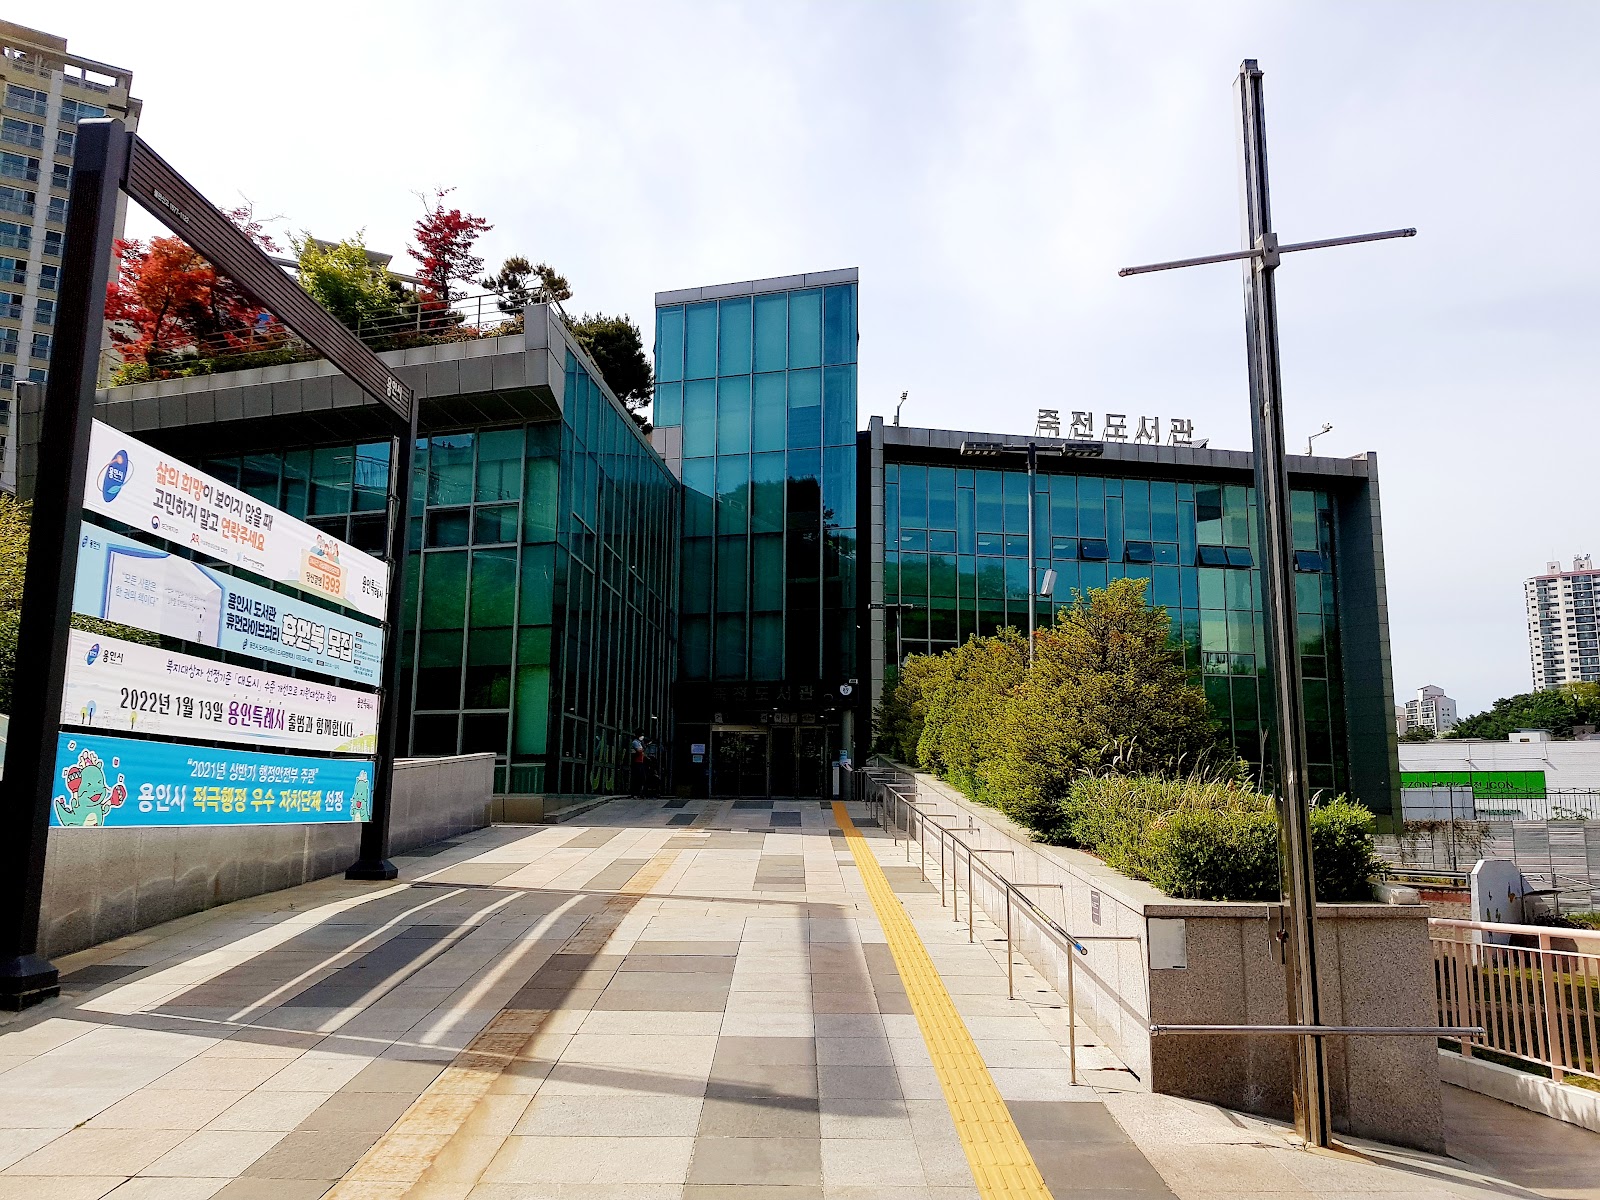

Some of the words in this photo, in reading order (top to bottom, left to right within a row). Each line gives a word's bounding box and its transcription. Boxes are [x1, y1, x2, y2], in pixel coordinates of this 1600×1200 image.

[1038, 408, 1194, 444] 죽전도서관
[156, 461, 180, 488] 삶의
[181, 472, 214, 504] 희망이
[214, 489, 243, 518] 보이지
[246, 503, 262, 528] 않을
[263, 513, 274, 532] 때
[152, 487, 198, 523] 고민하지
[200, 507, 218, 532] 말고
[221, 517, 264, 551] 연락주세요
[116, 585, 122, 598] 한
[322, 574, 340, 594] 1393
[228, 592, 252, 615] 용인시
[254, 602, 277, 622] 도서관
[226, 612, 280, 642] 휴먼라이브러리
[281, 613, 326, 654] 휴먼북
[327, 627, 353, 662] 모집
[102, 649, 124, 663] 용인시
[166, 658, 204, 679] 복지대상자
[206, 667, 232, 686] 선정기준
[264, 680, 276, 694] 수준
[277, 683, 298, 696] 개선으로
[300, 687, 326, 702] 지원대상자
[327, 690, 337, 704] 확대
[120, 687, 170, 716] 2022년
[175, 696, 194, 718] 1월
[198, 700, 223, 722] 13일
[228, 700, 285, 731] 용인특례시
[288, 712, 314, 734] 출범과
[229, 762, 256, 782] 상반기
[258, 764, 298, 784] 행정안전부
[138, 782, 187, 813] 용인시
[192, 786, 248, 813] 적극행정
[250, 788, 276, 812] 우수
[279, 788, 322, 812] 자치단체
[324, 790, 344, 812] 선정
